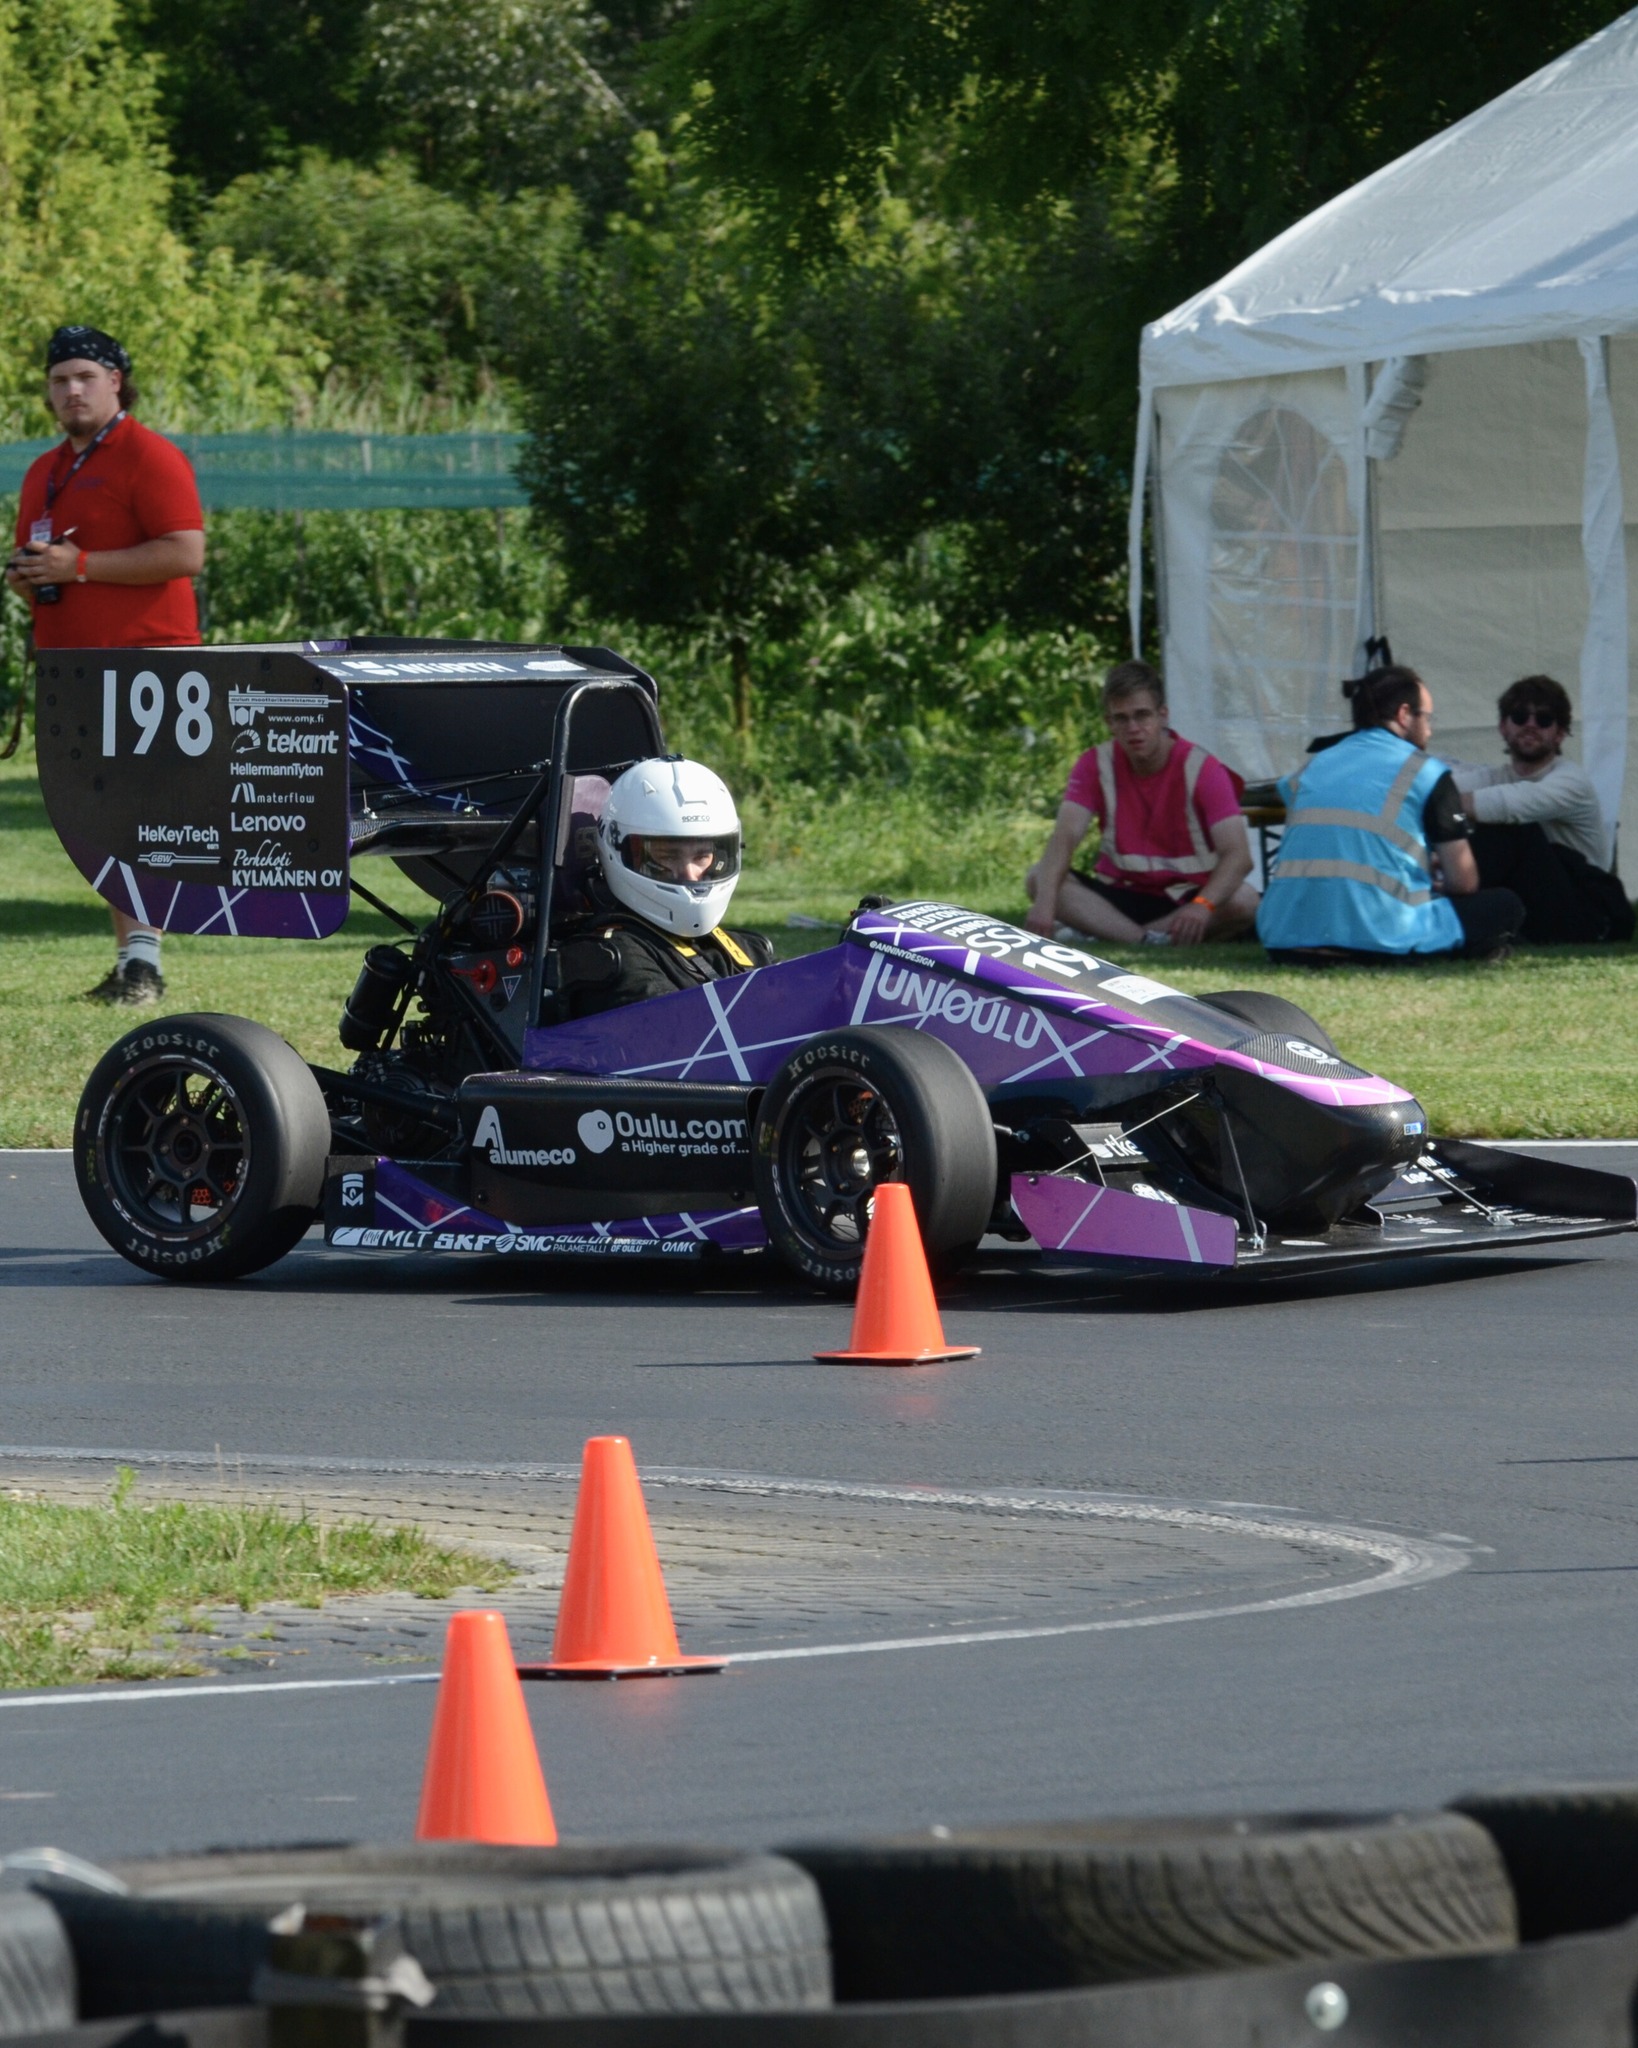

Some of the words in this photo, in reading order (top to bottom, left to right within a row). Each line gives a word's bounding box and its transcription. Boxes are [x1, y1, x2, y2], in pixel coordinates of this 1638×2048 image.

[102, 669, 213, 757] 198
[267, 729, 339, 754] tekant
[230, 763, 324, 779] HellermannTyton
[257, 792, 315, 803] materflow
[231, 812, 306, 832] Lenovo
[138, 825, 219, 845] HeKeyTech
[233, 839, 292, 867] Perhekoti
[232, 867, 317, 887] KYLMÄNEN
[320, 870, 343, 887] OY
[869, 940, 935, 968] @ANNINYDESIGN
[1022, 944, 1100, 978] 19
[877, 962, 1042, 1049] UNIOULU
[122, 1033, 220, 1061] Hoosier
[788, 1044, 870, 1080] Hoosier
[615, 1111, 749, 1139] Oulu.com
[489, 1148, 576, 1165] alumeco
[621, 1143, 631, 1152] a
[632, 1140, 676, 1157] Higher
[679, 1143, 718, 1157] grade
[721, 1142, 750, 1154] of...
[381, 1230, 433, 1248] MLT
[433, 1233, 495, 1251] SKF
[514, 1234, 552, 1253] SMC
[552, 1243, 606, 1254] PALAMETALLI
[610, 1244, 622, 1253] OF
[621, 1244, 643, 1253] OULU
[613, 1237, 660, 1246] UNIVERSITY
[801, 1256, 862, 1283] osier
